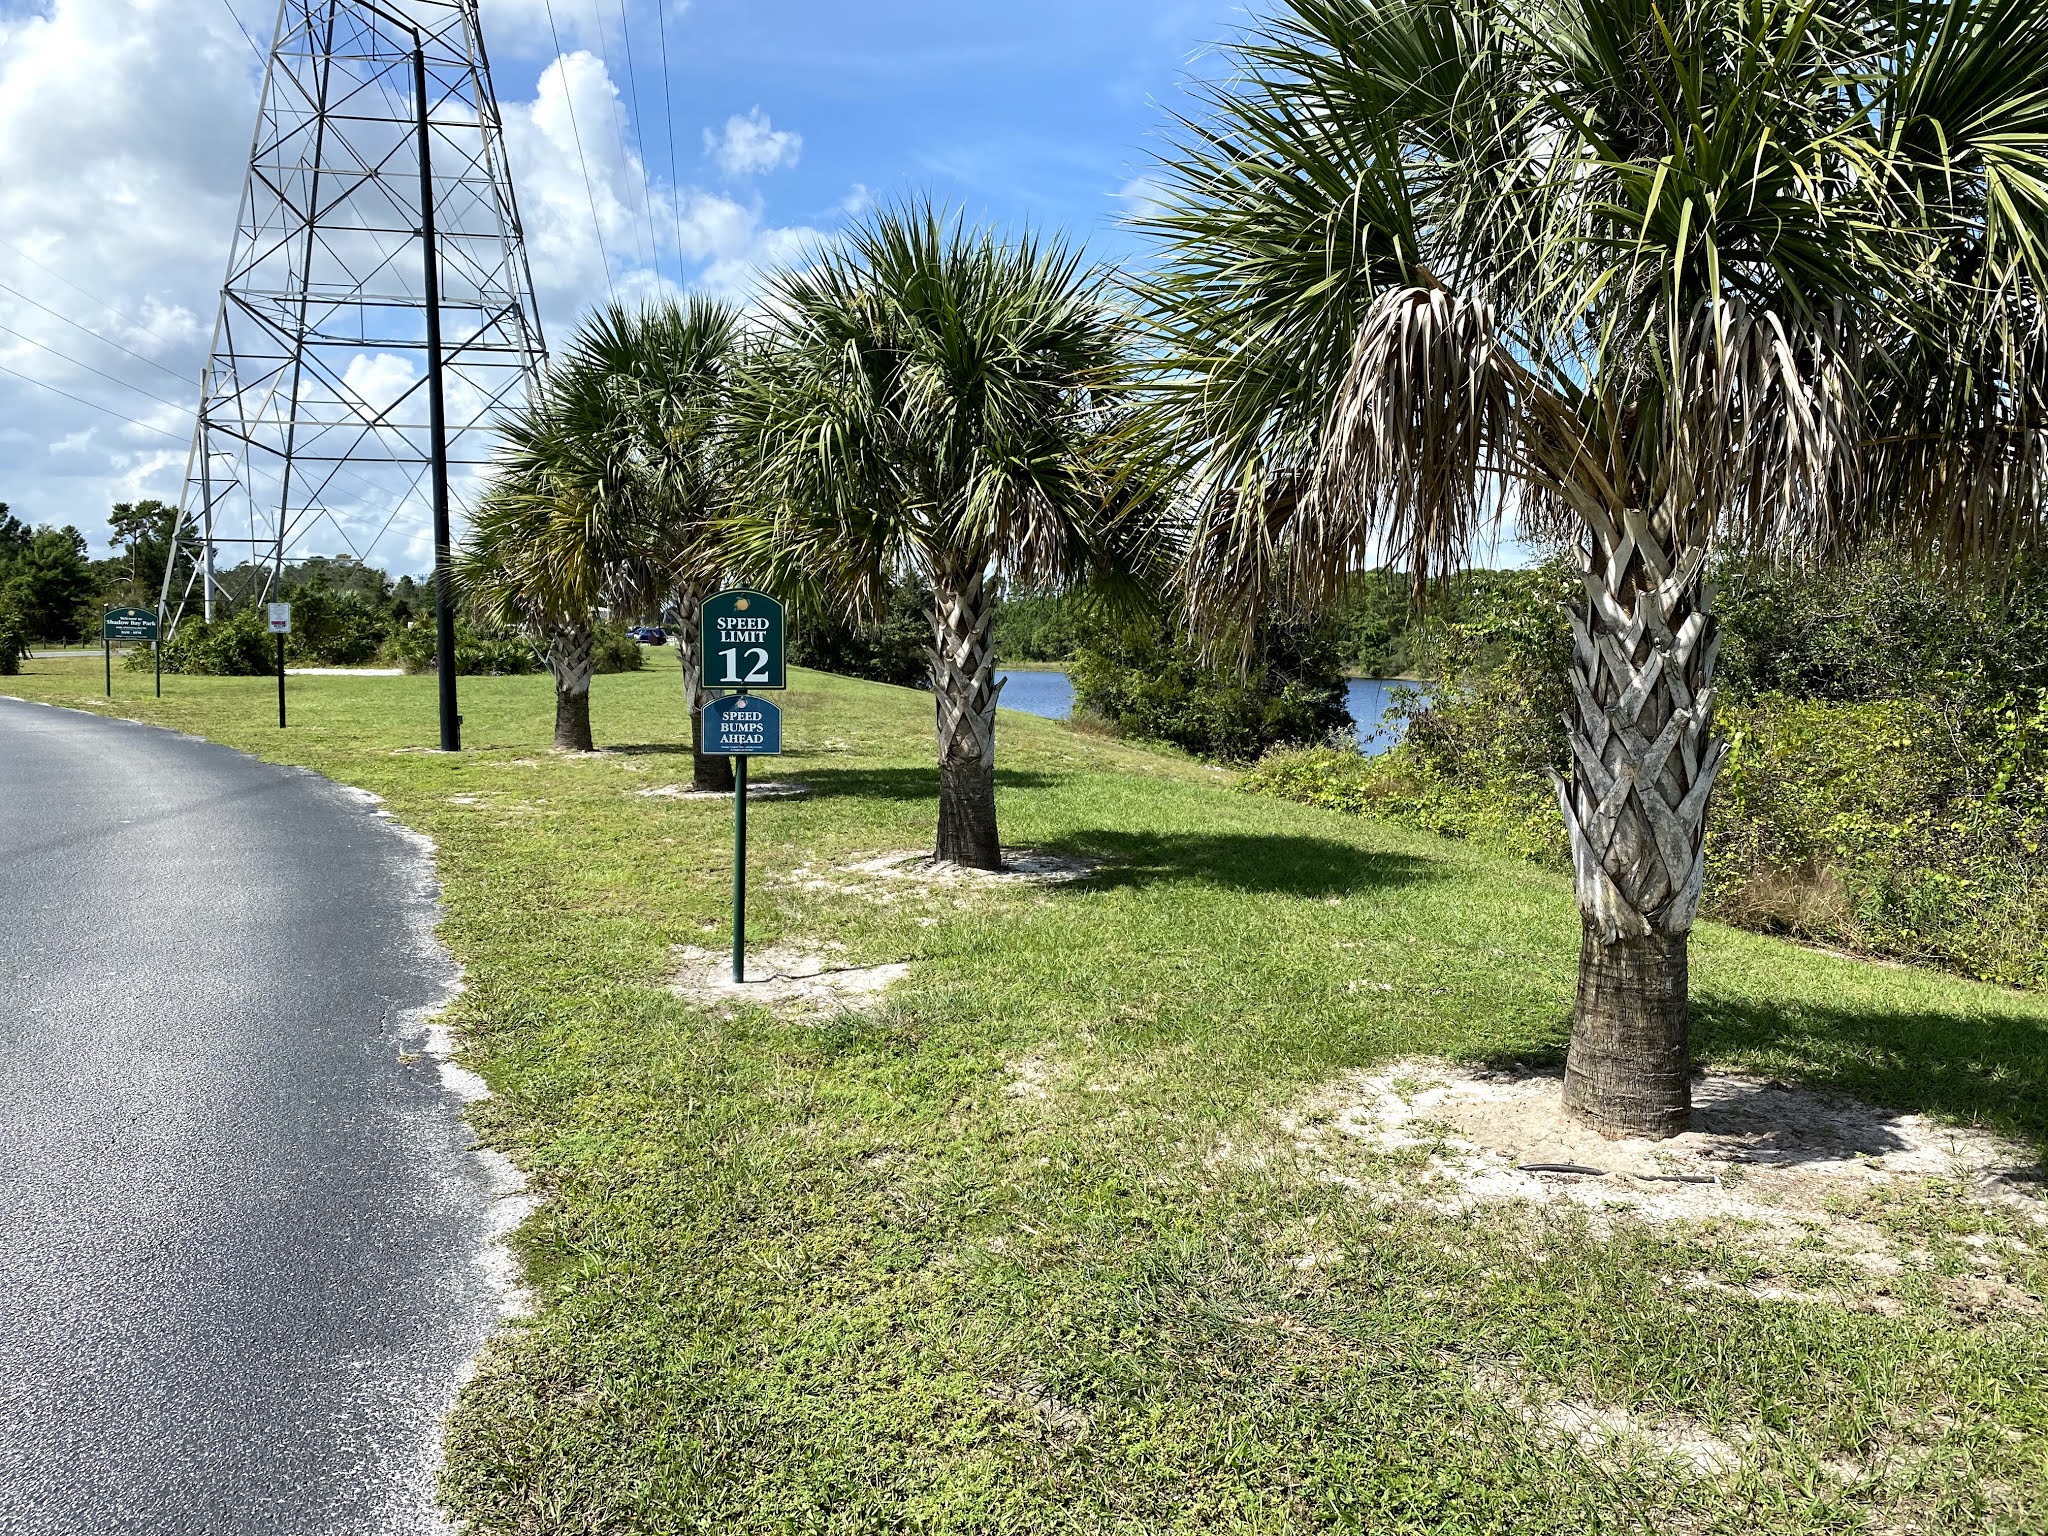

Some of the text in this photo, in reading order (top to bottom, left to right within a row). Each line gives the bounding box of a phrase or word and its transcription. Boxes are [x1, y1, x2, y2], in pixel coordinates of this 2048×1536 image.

[717, 617, 769, 630] SPEED
[720, 631, 766, 642] LIMIT
[718, 648, 768, 682] 12
[722, 712, 762, 721] SPEED
[720, 723, 763, 732] BUMPS
[720, 734, 763, 743] AHEAD
